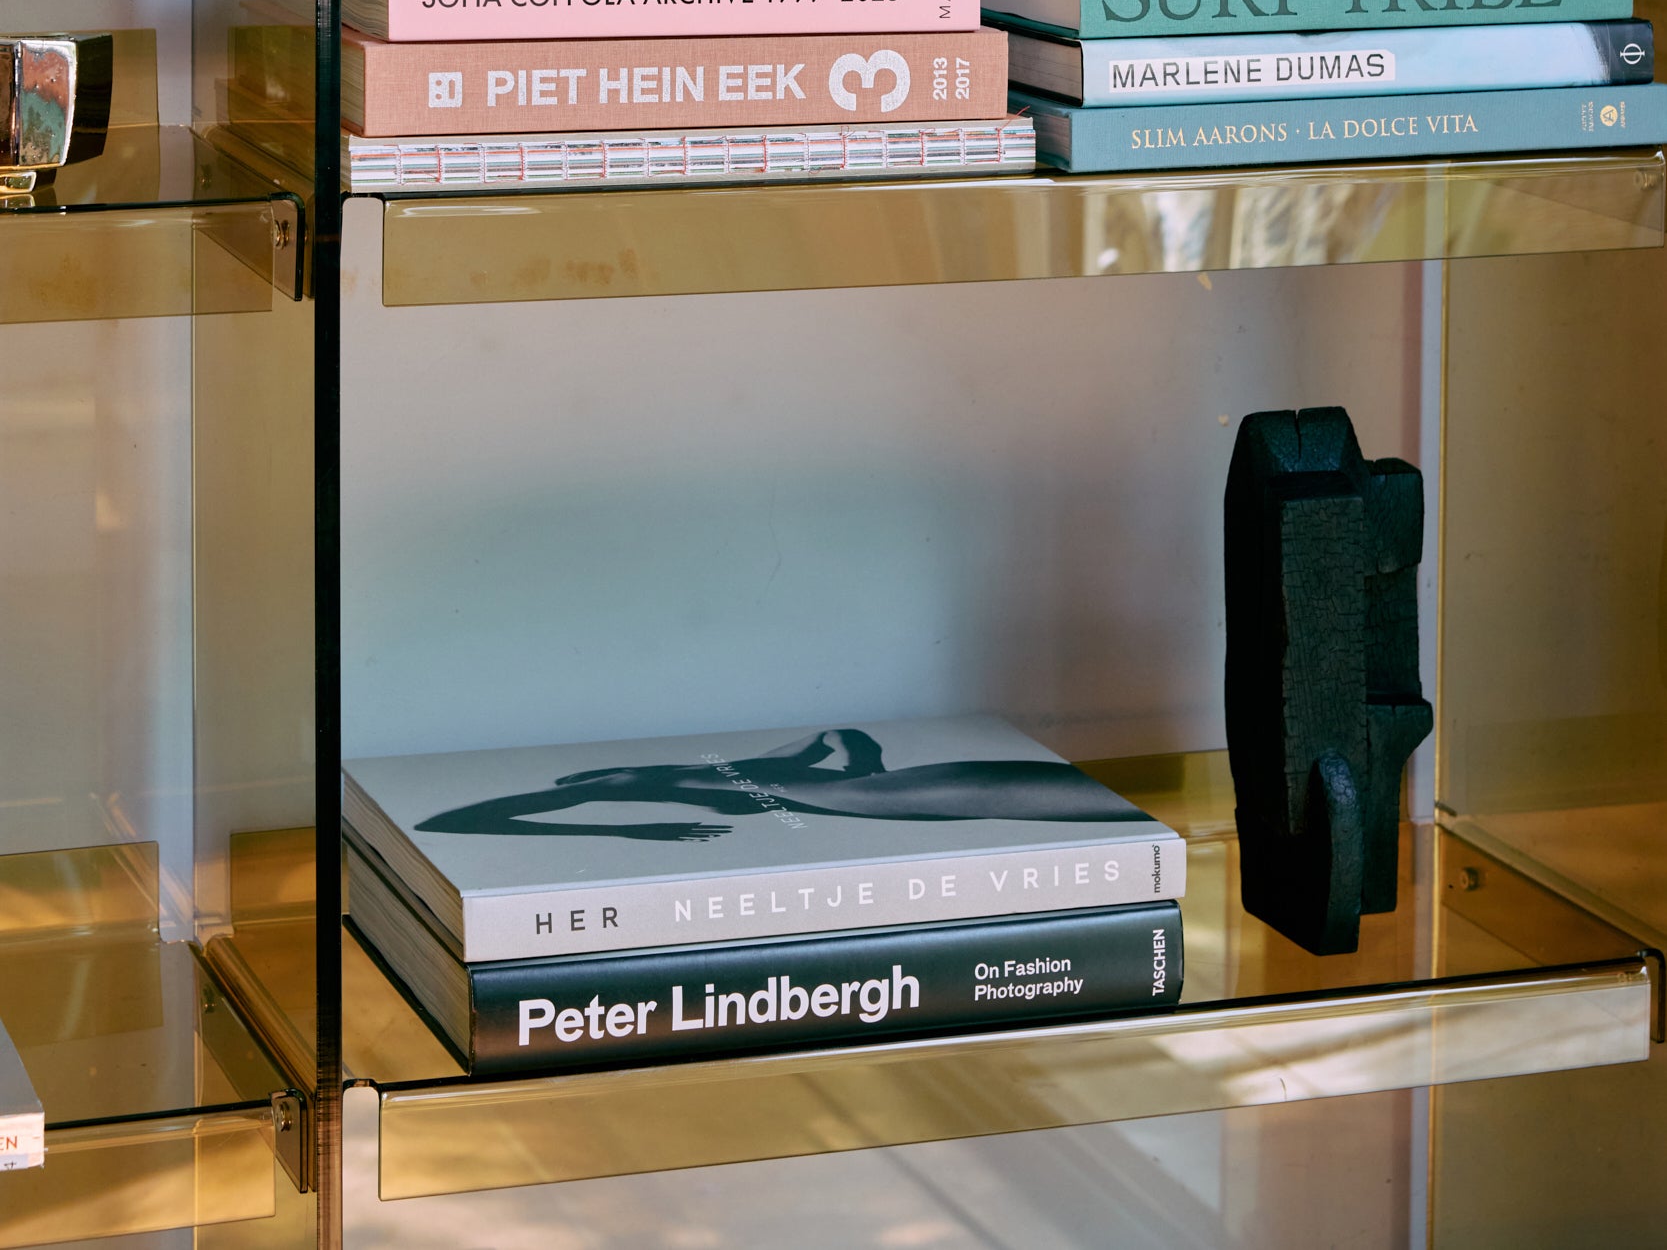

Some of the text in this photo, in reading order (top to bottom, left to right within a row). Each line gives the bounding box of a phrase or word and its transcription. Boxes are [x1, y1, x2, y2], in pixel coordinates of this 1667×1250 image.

[487, 49, 912, 113] PIET HEIN EEK 3
[932, 56, 948, 101] 2013
[955, 56, 971, 101] 2017
[1112, 53, 1386, 89] MARLENE DUMAS
[1131, 127, 1187, 150] SLIM
[1193, 122, 1288, 146] AARONS
[1307, 120, 1336, 140] LA
[1343, 116, 1419, 139] DOLCE
[1426, 114, 1480, 134] VITA
[748, 791, 808, 830] NEELTJE
[535, 860, 1120, 935] HER NEELTJE DE VRIES
[974, 957, 1072, 981] On Fashion
[1152, 928, 1166, 997] TASCHEN
[518, 964, 921, 1047] Peter Lindbergh
[974, 976, 1084, 1001] Photography
